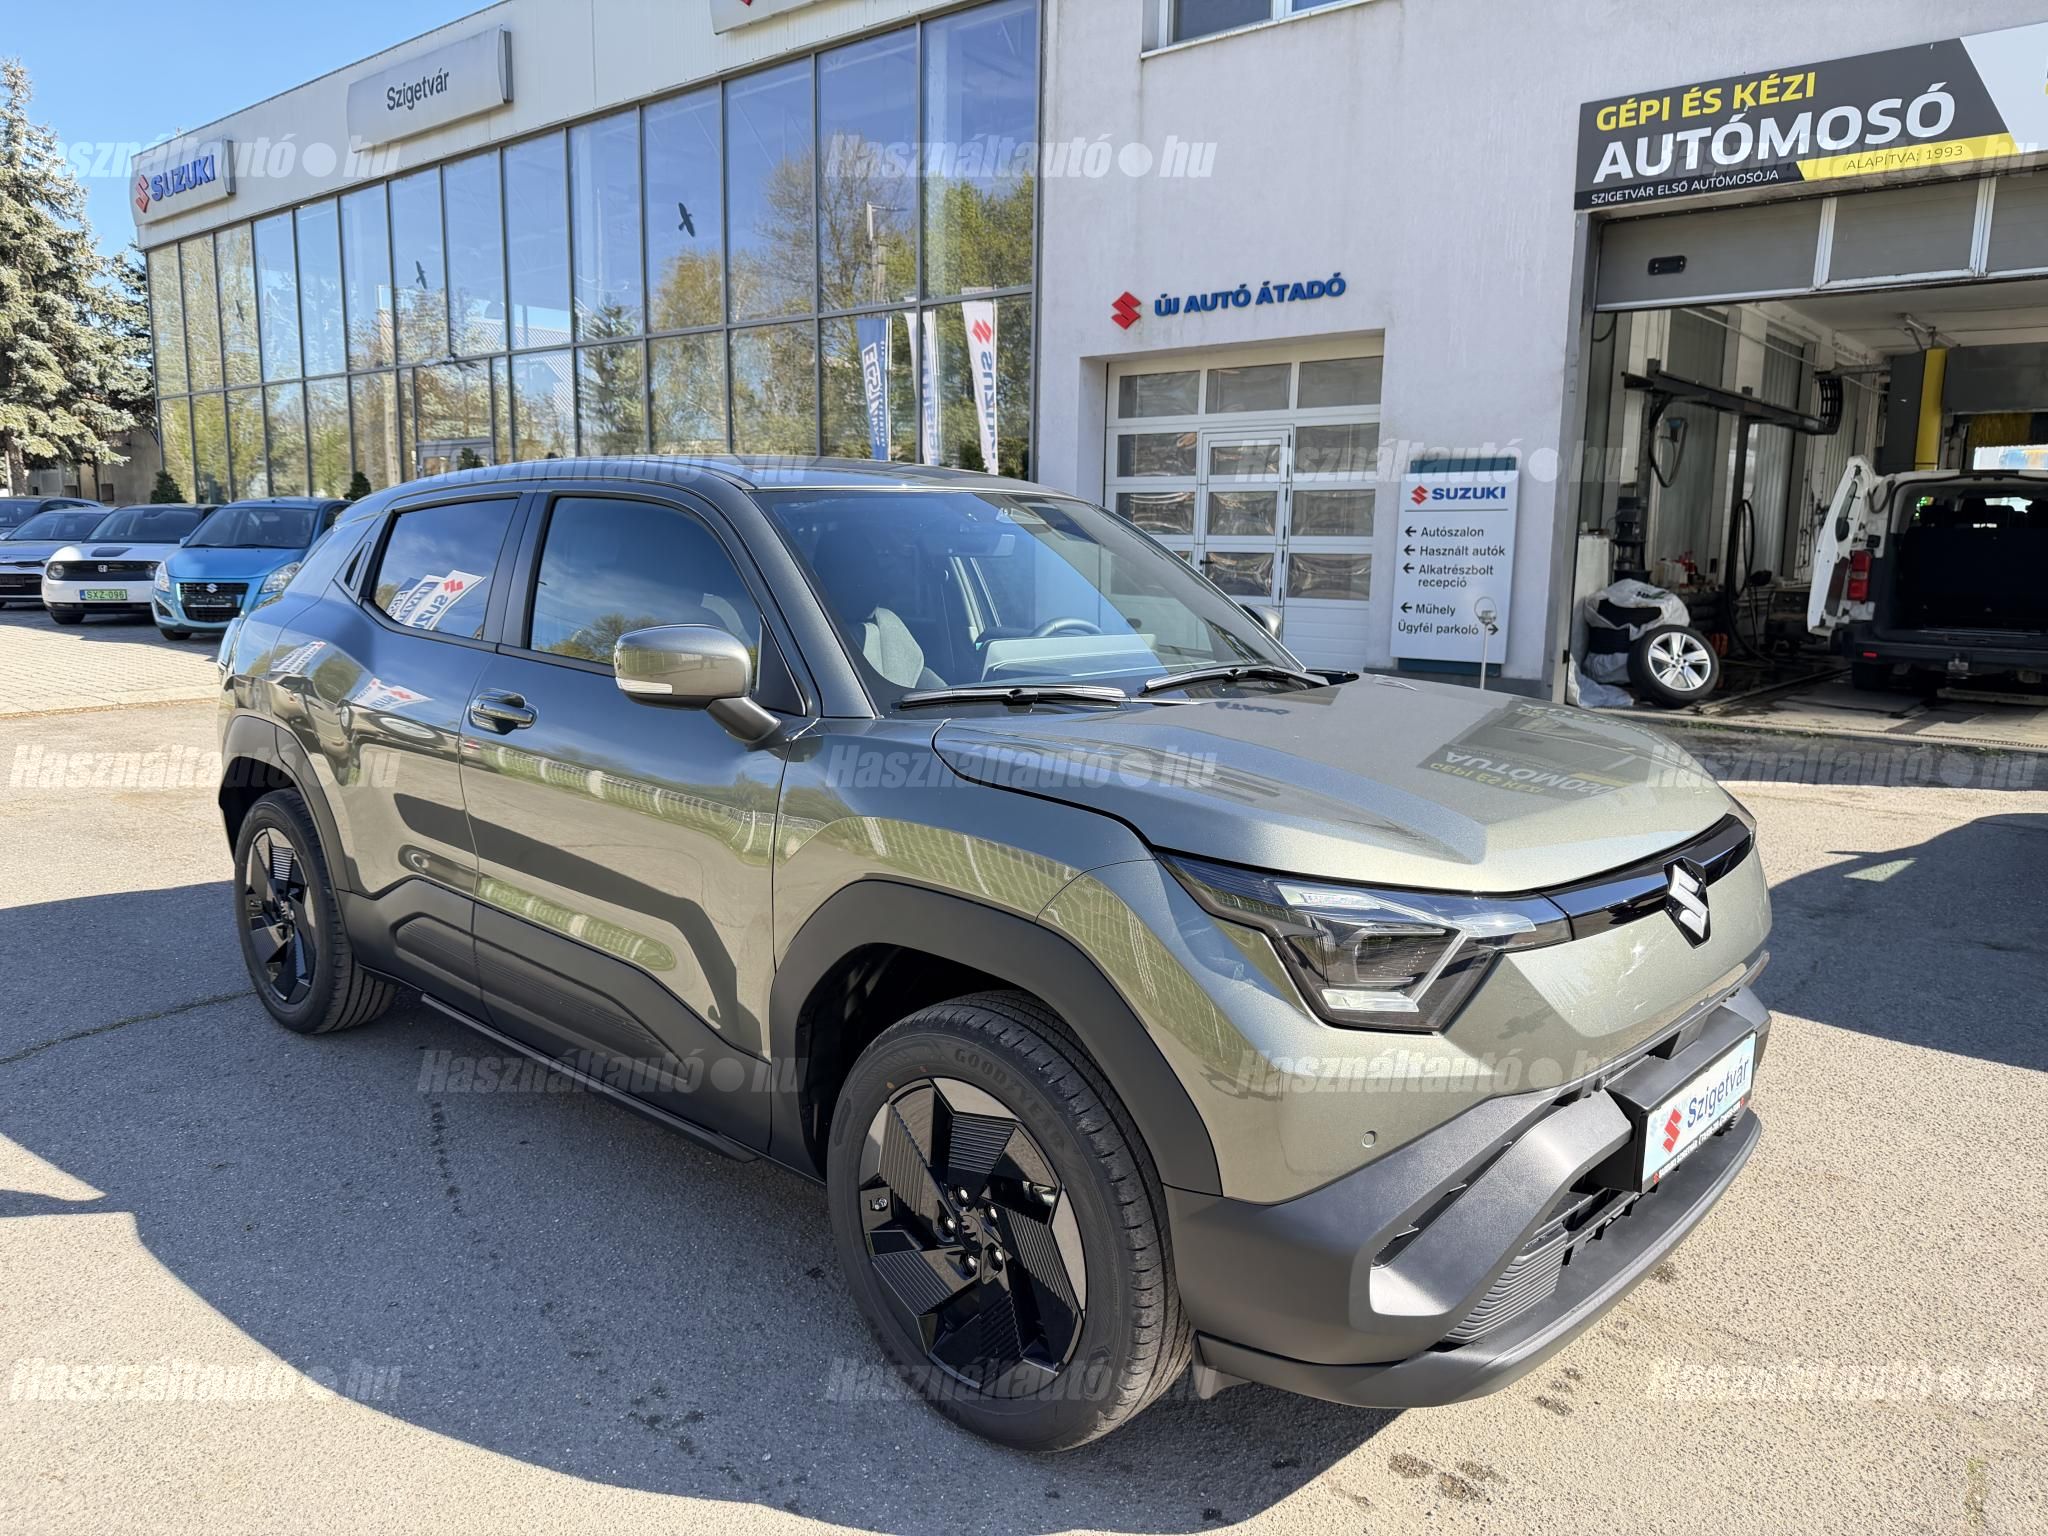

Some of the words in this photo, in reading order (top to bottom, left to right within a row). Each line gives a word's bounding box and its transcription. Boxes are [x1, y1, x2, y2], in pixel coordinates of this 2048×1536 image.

[386, 68, 450, 113] Szigetvár
[1596, 97, 1670, 132] GÉPI
[1682, 87, 1722, 118] ÉS
[1733, 72, 1816, 110] KÉZI
[1593, 82, 1956, 184] AUTÓMOSÓ
[1846, 148, 1920, 172] ALAPÍTVA:
[1926, 143, 1964, 160] 1993
[151, 154, 216, 202] SUZUKI
[1591, 185, 1654, 206] SZIGETVÁR
[1657, 179, 1689, 198] ELSŐ
[1691, 168, 1779, 193] AUTÓMOSÓJA
[1154, 291, 1180, 317] ÚJ
[1184, 283, 1251, 313] AUTÓ
[1255, 272, 1346, 307] ÁTADÓ
[1431, 486, 1506, 500] SUZUKI
[1420, 526, 1485, 538] Autószalon
[1419, 545, 1469, 557] Használt
[1472, 545, 1505, 556] autók
[1418, 564, 1494, 576] Alkatrészbolt
[1418, 576, 1467, 590] recepció
[1415, 603, 1456, 616] Műhely
[1398, 620, 1433, 635] Ügyfél
[1436, 622, 1479, 636] parkoló
[1686, 1056, 1750, 1129] Szigetvár
